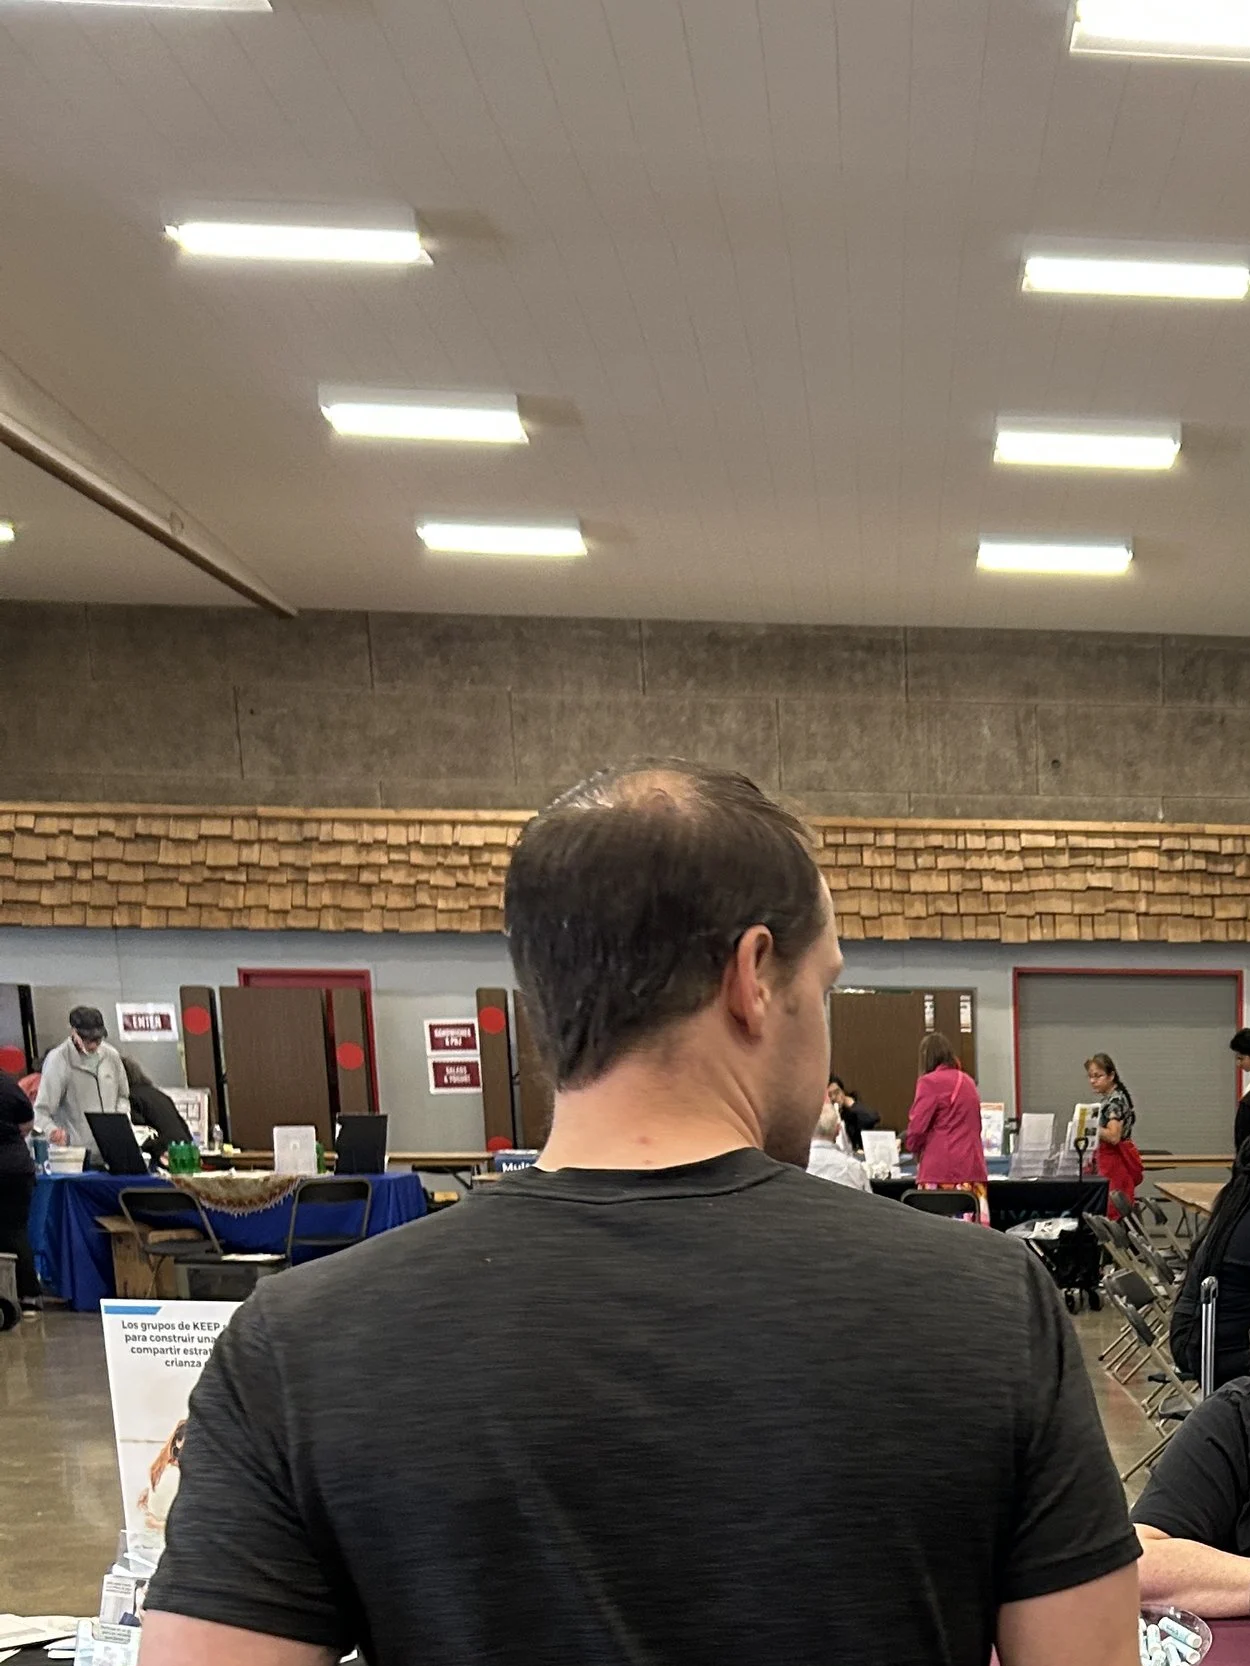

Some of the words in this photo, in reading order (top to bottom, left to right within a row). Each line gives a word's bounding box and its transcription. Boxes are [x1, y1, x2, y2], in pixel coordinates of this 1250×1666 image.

[122, 1320, 139, 1331] Los
[141, 1321, 175, 1333] grupos
[178, 1320, 191, 1331] de
[193, 1321, 220, 1332] KEEP
[125, 1333, 147, 1344] para
[149, 1332, 195, 1344] construir
[131, 1346, 181, 1357] compartir
[165, 1358, 202, 1368] crianza
